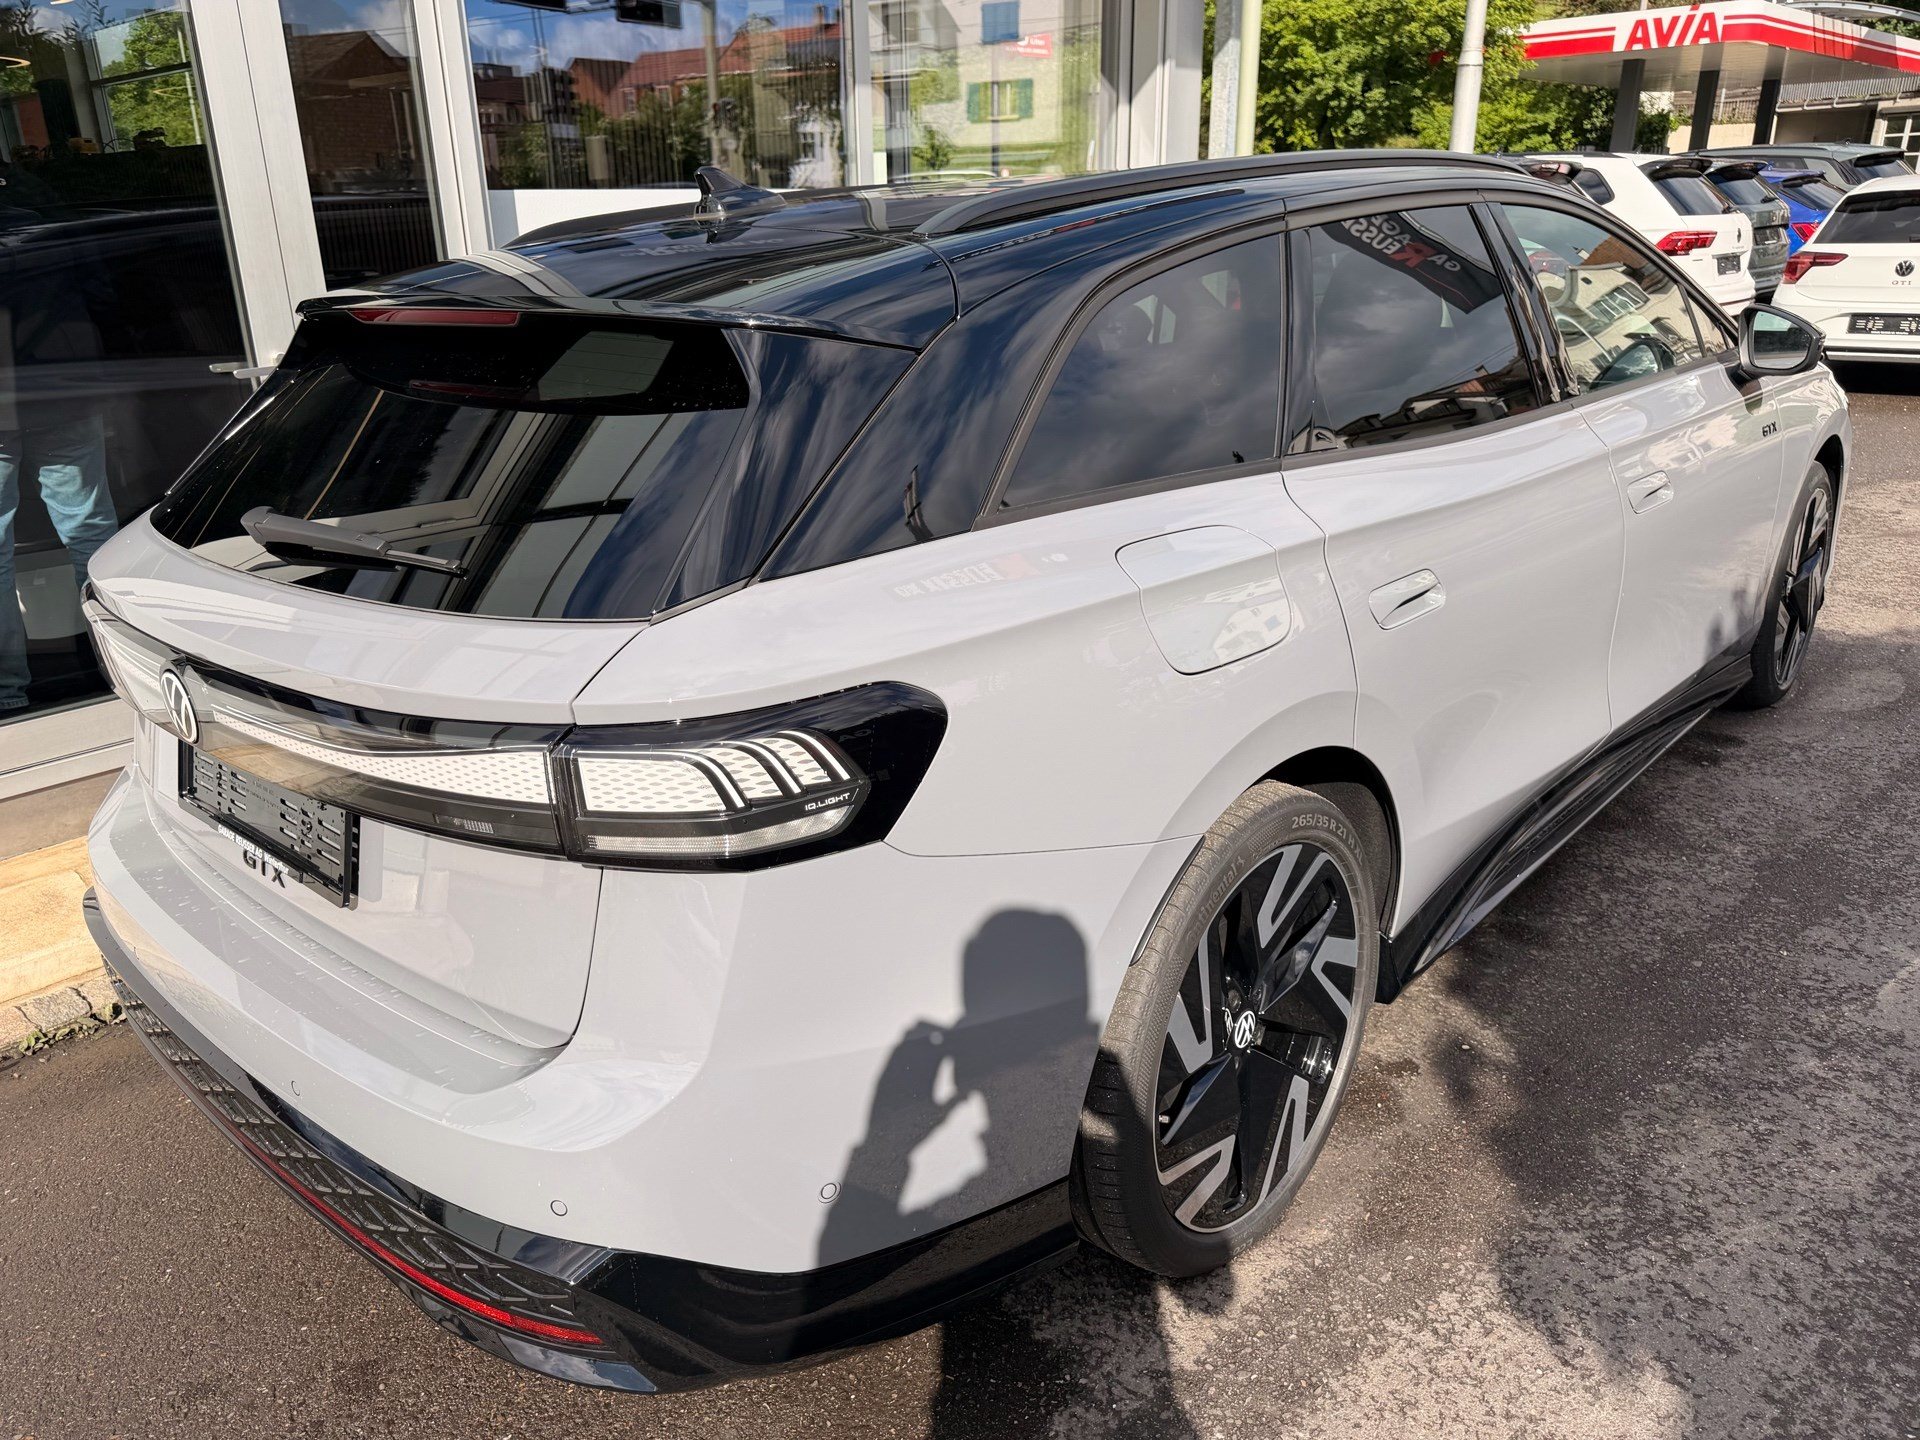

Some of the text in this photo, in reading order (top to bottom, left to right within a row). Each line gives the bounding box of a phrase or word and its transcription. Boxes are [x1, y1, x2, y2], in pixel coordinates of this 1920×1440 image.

[1762, 421, 1777, 437] GTX
[804, 792, 851, 811] IQ.LIGHT
[1291, 813, 1329, 829] 265/35
[1329, 818, 1337, 832] R
[1336, 823, 1347, 840] 21
